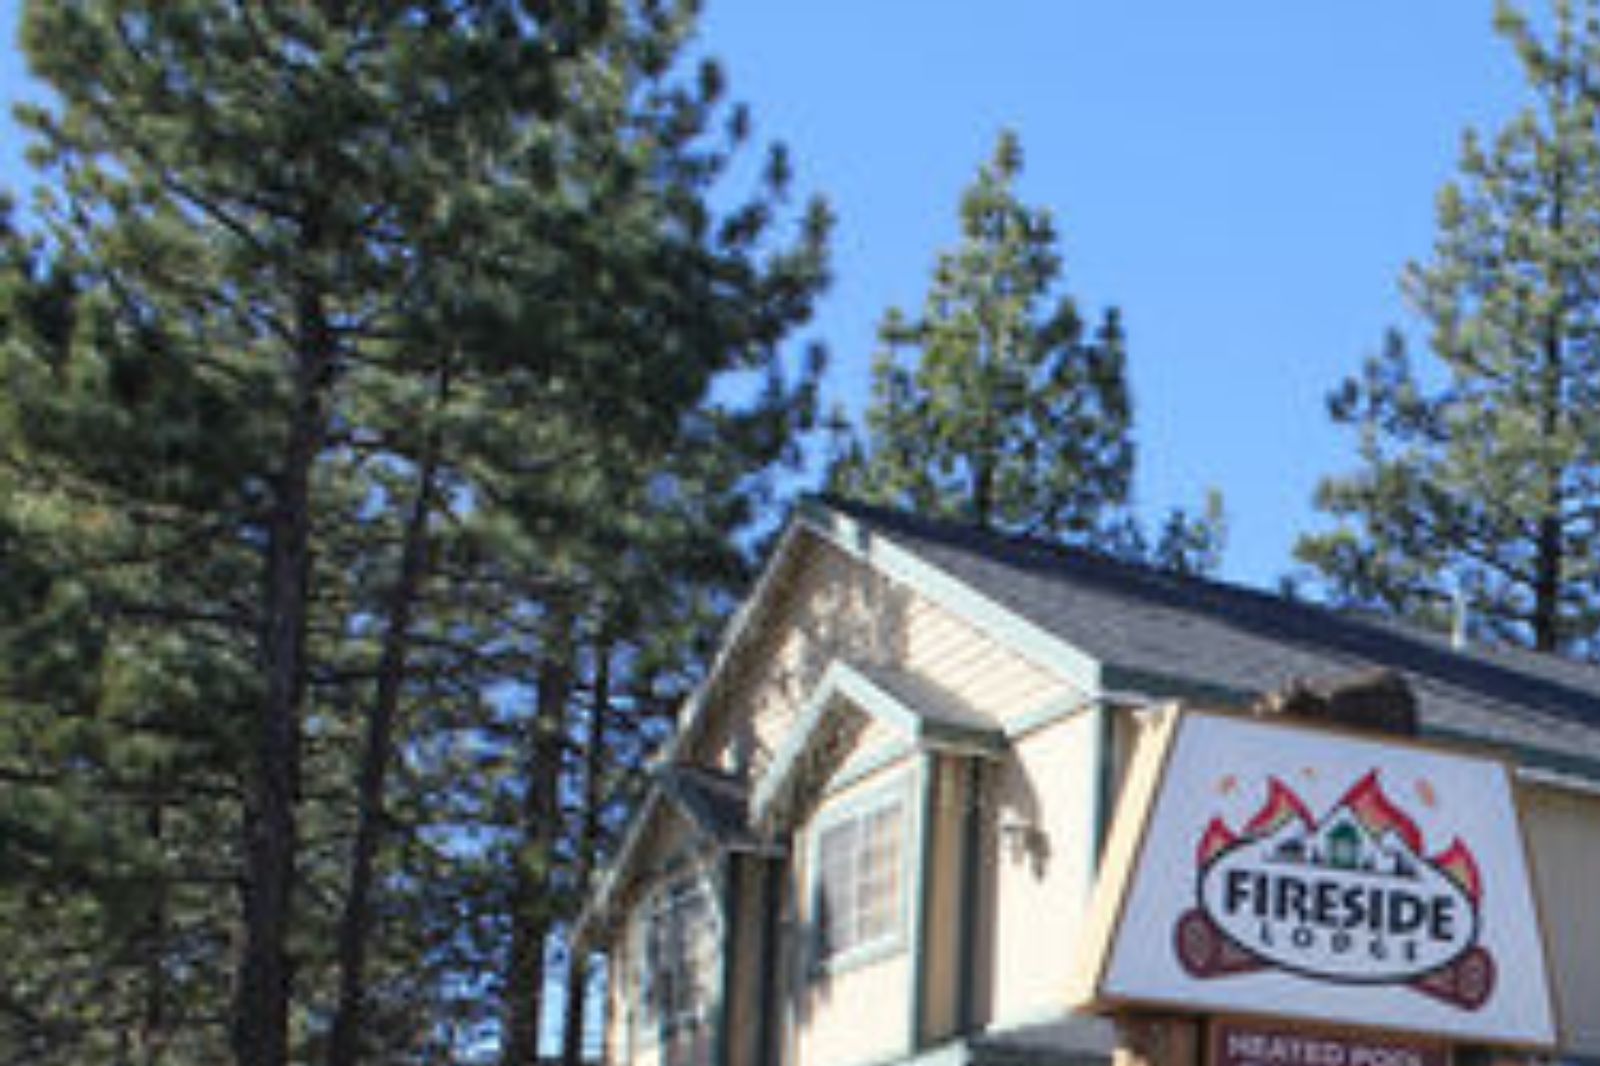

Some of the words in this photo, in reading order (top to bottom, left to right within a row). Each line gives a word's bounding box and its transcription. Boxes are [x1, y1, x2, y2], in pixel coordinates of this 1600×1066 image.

[1226, 869, 1455, 941] FIRESIDE
[1259, 924, 1420, 961] LODGE
[1226, 1030, 1346, 1066] HEATED
